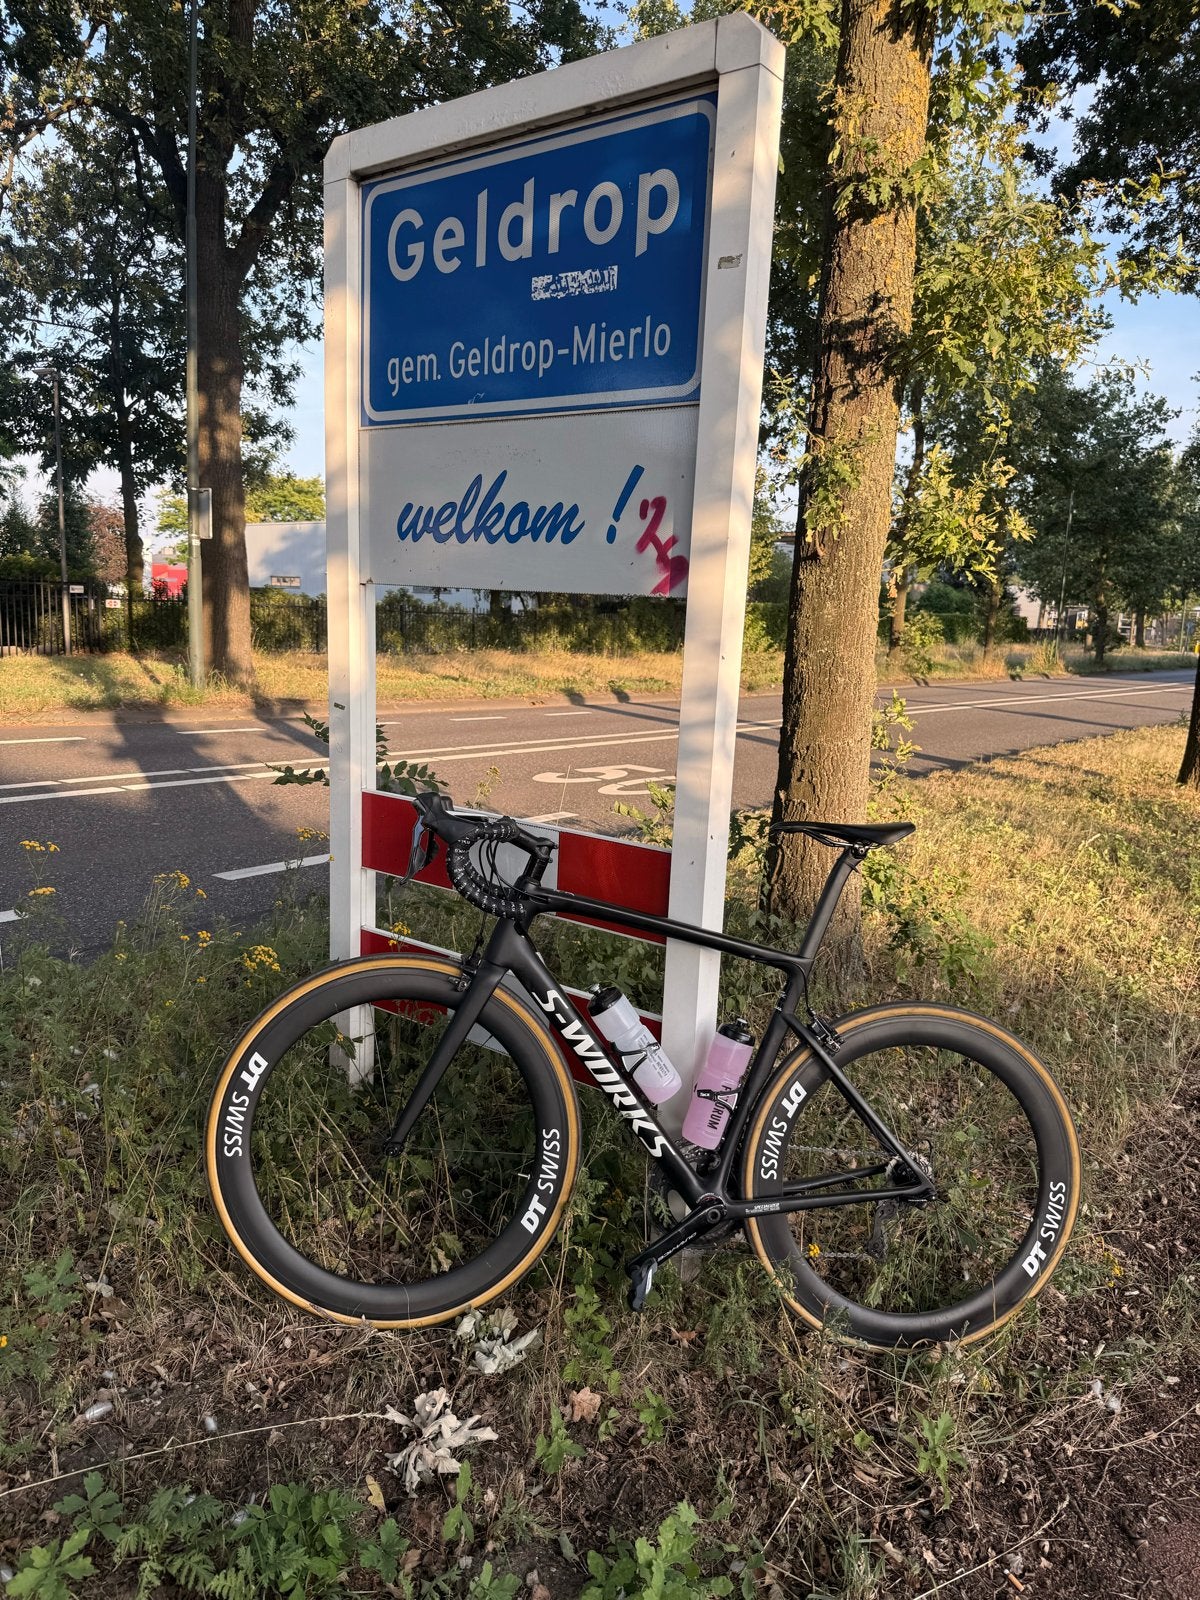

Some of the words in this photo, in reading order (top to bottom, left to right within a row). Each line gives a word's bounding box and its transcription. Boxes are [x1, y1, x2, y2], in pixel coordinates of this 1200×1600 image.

[387, 168, 680, 282] Geldrop
[387, 353, 442, 397] gem.
[449, 315, 671, 379] Geldrop-Mierlo
[397, 469, 586, 545] welkom
[240, 1051, 269, 1092] DT
[532, 988, 676, 1158] S-WORKS
[781, 1080, 808, 1119] DT
[223, 1090, 250, 1158] SWISS
[760, 1115, 788, 1181] SWISS
[520, 1193, 548, 1235] DT
[537, 1127, 561, 1195] SWISS
[1021, 1239, 1047, 1279] DT
[1040, 1180, 1067, 1244] SWISS
